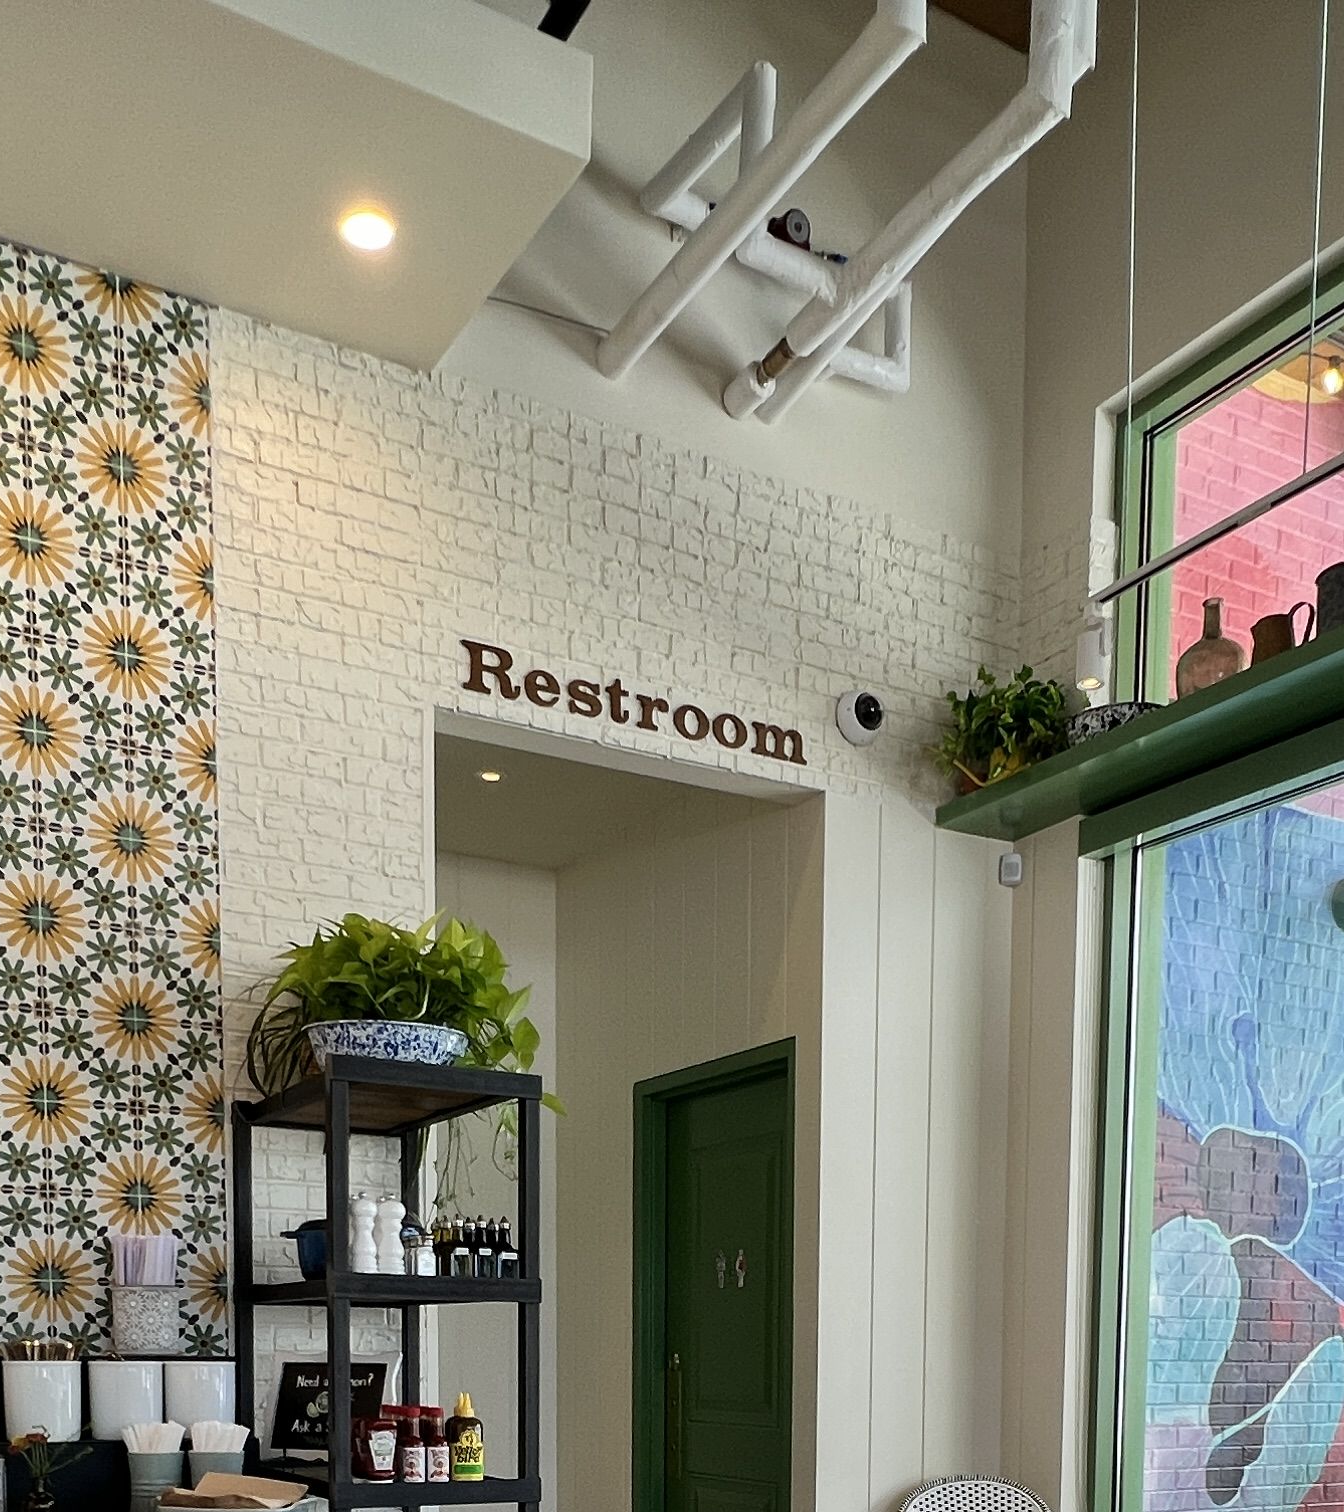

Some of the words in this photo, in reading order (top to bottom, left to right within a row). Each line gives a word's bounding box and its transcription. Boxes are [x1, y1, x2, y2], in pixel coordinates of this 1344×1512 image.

[459, 638, 808, 766] Restroom
[296, 1375, 319, 1388] Need
[291, 1419, 310, 1432] Ask
[315, 1423, 322, 1432] a
